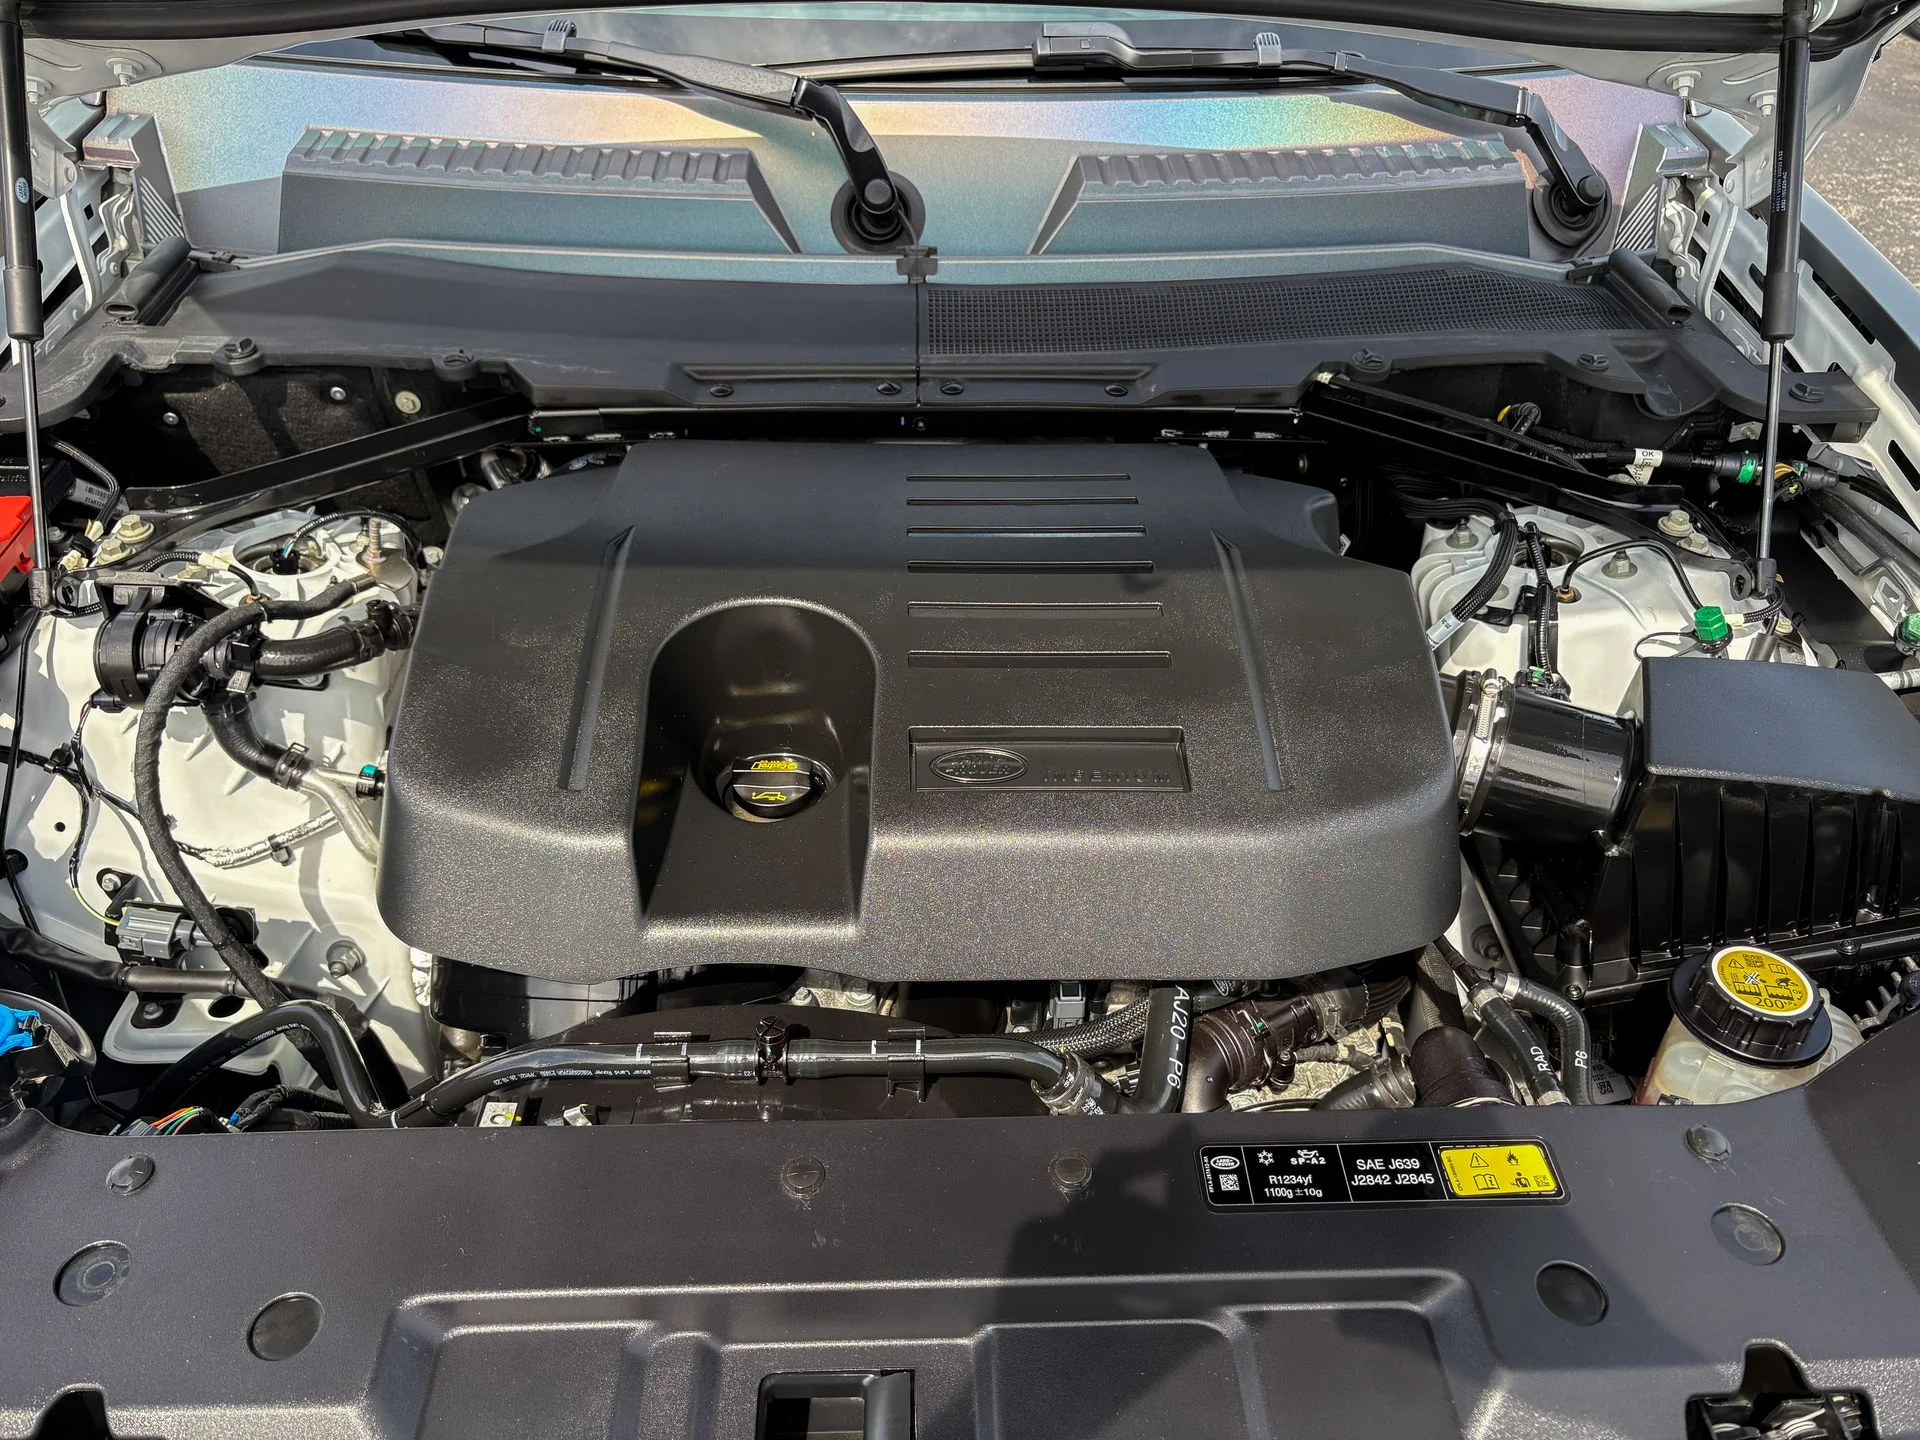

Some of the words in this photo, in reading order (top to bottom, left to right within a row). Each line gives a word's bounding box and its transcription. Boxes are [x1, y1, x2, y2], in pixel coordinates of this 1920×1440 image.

[1043, 768, 1171, 783] INGENIUM
[1530, 1046, 1551, 1072] RAD
[1574, 1050, 1588, 1069] P6
[1290, 1157, 1326, 1165] SP-A2
[1356, 1158, 1386, 1170] SAE
[1388, 1157, 1420, 1170] J639
[1268, 1174, 1313, 1186] R1234yf
[1351, 1174, 1392, 1186] J2842
[1394, 1173, 1435, 1185] J2845
[1264, 1187, 1293, 1199] 1100g
[1295, 1187, 1323, 1198] ±10g
